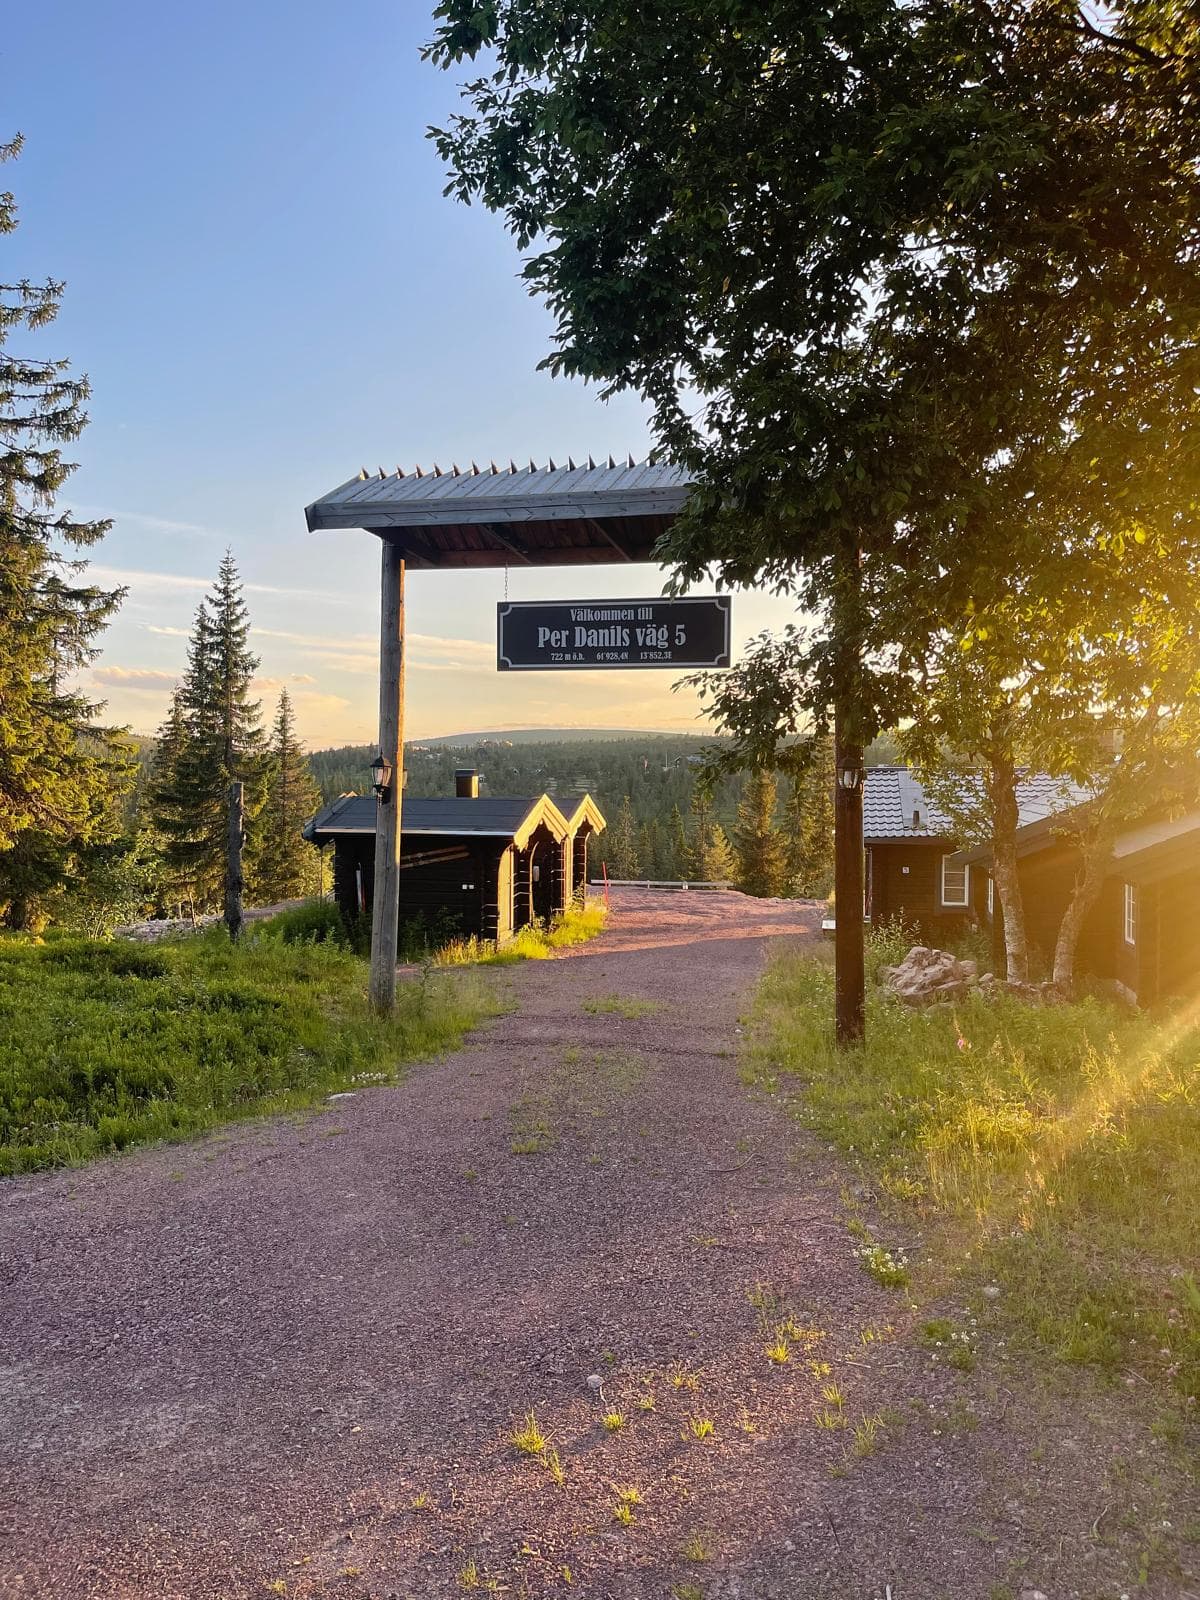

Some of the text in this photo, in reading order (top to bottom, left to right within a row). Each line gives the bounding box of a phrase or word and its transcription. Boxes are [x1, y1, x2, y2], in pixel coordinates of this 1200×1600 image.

[570, 607, 653, 621] Välkommen till
[538, 624, 687, 649] Per Danils väg 5
[550, 652, 563, 661] 722
[564, 653, 571, 661] m
